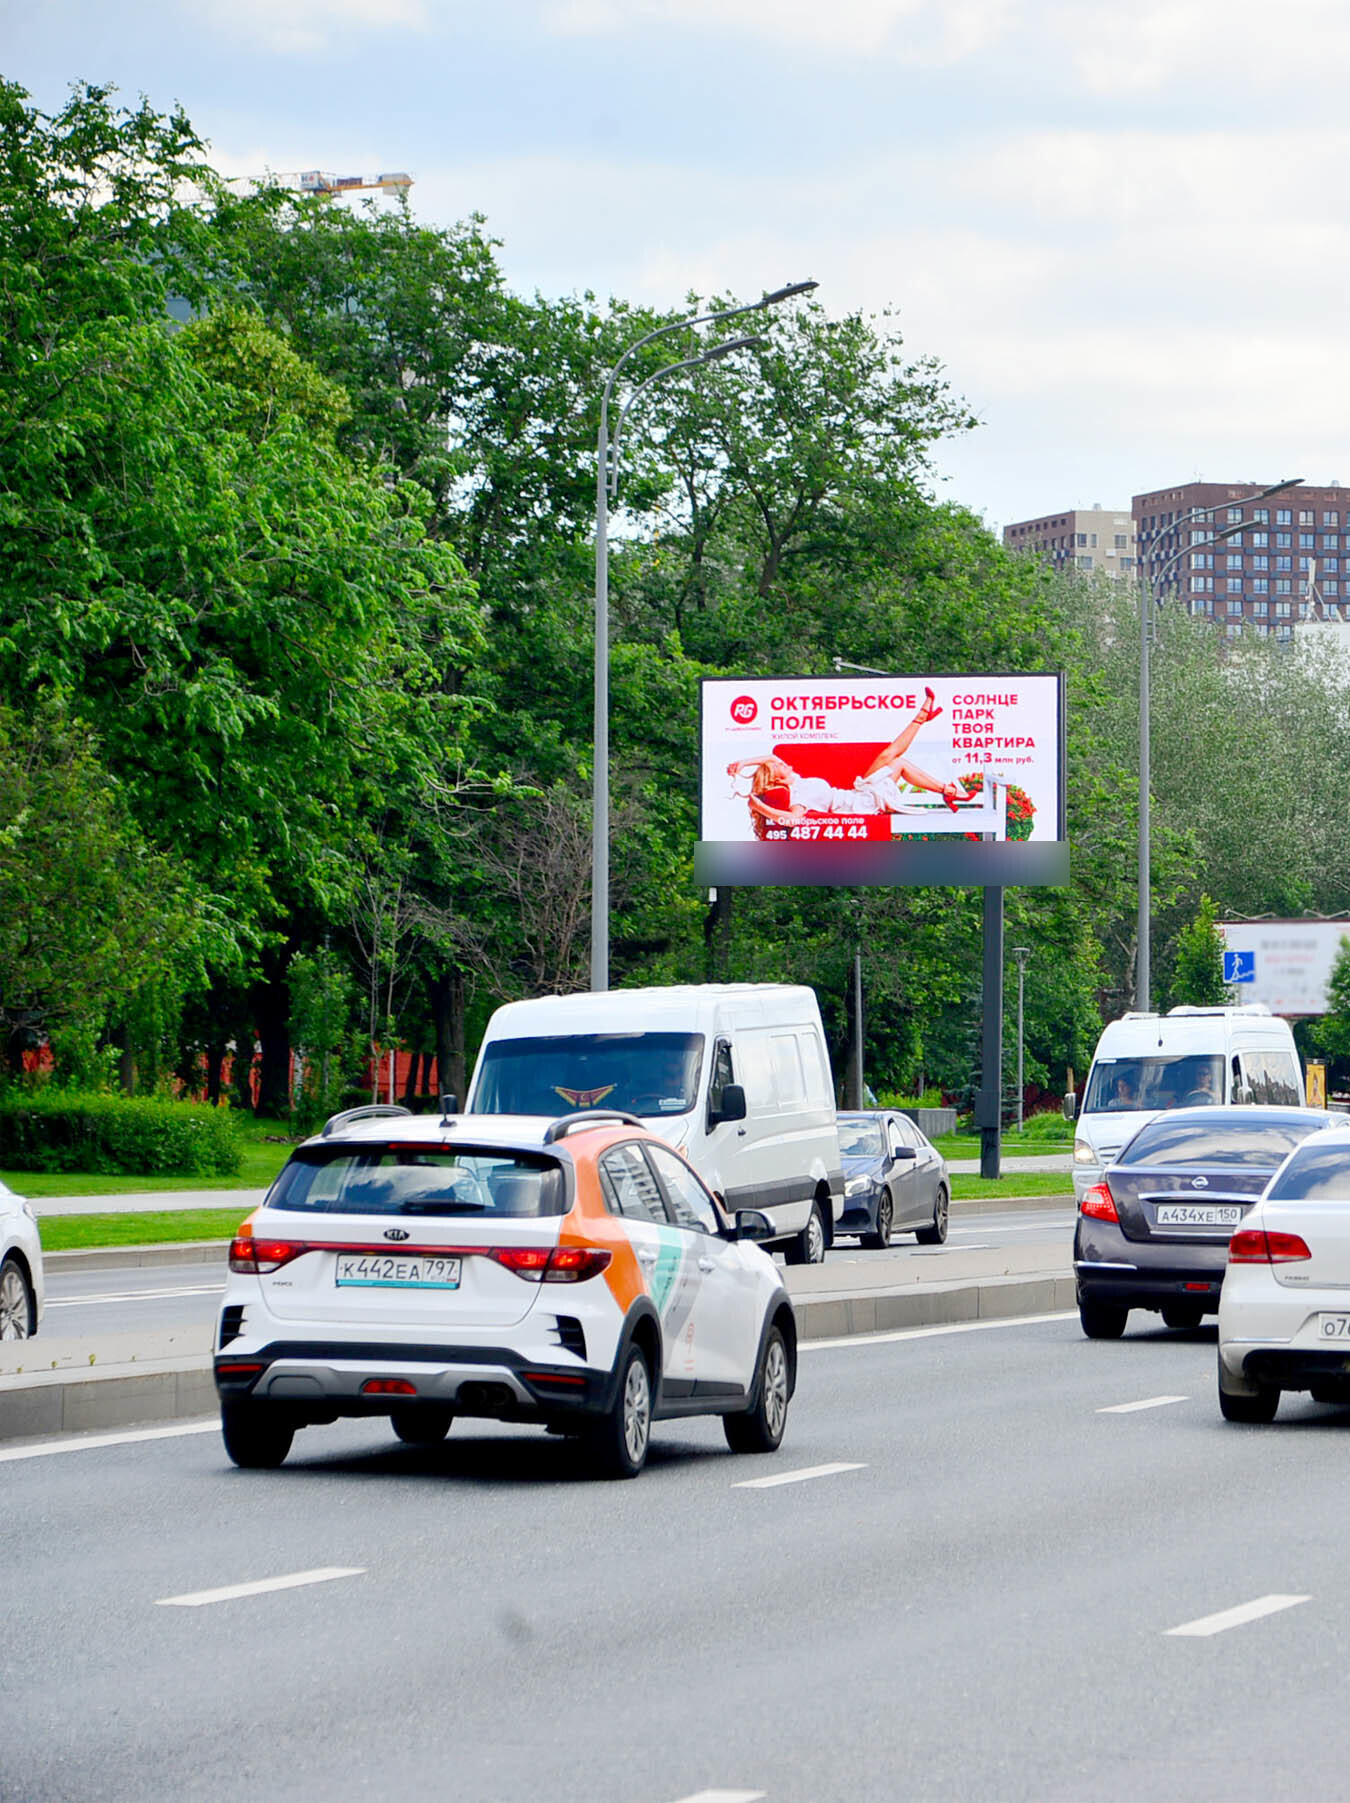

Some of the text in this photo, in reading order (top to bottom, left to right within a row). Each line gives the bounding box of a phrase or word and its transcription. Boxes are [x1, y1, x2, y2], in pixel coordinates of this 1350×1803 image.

[770, 694, 917, 711] ОКТЯБРЬСКОЕ
[952, 694, 1019, 707] СОЛНЦЕ
[952, 708, 995, 720] ПАРК
[770, 715, 827, 731] ПОЛЕ
[952, 723, 994, 734] ТВОЯ
[952, 737, 1036, 749] КВАРТИРА
[964, 752, 992, 765] 11,3
[841, 817, 865, 825] поле
[765, 825, 868, 840] 495 487 44 44
[1218, 1208, 1237, 1219] 150
[385, 1229, 407, 1241] KIA
[425, 1259, 456, 1276] 797
